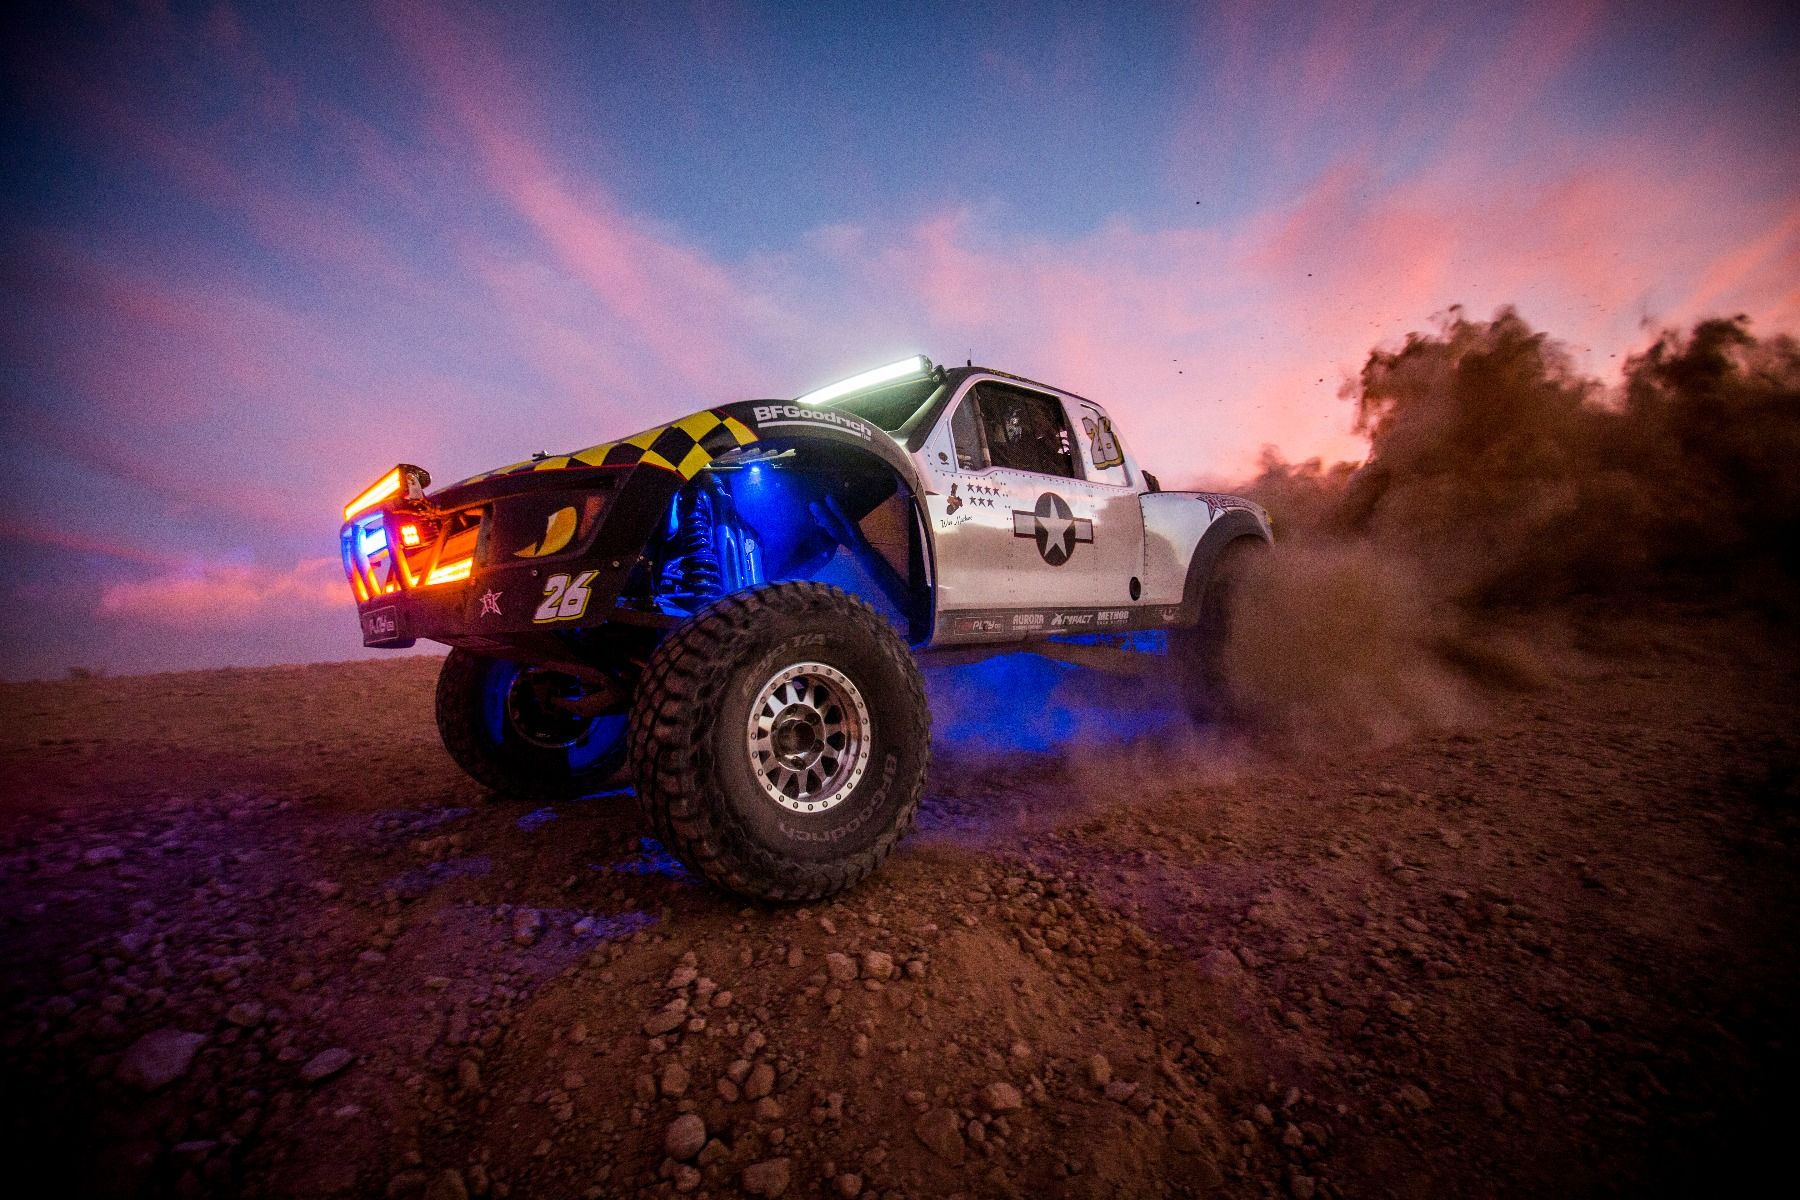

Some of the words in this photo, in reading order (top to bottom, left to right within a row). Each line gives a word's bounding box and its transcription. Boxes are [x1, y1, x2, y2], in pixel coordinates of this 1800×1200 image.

[753, 405, 872, 437] BFGoodrich
[1082, 416, 1125, 470] 26
[531, 569, 600, 624] 26
[1012, 614, 1044, 625] AURORA
[1097, 611, 1130, 621] METHOD
